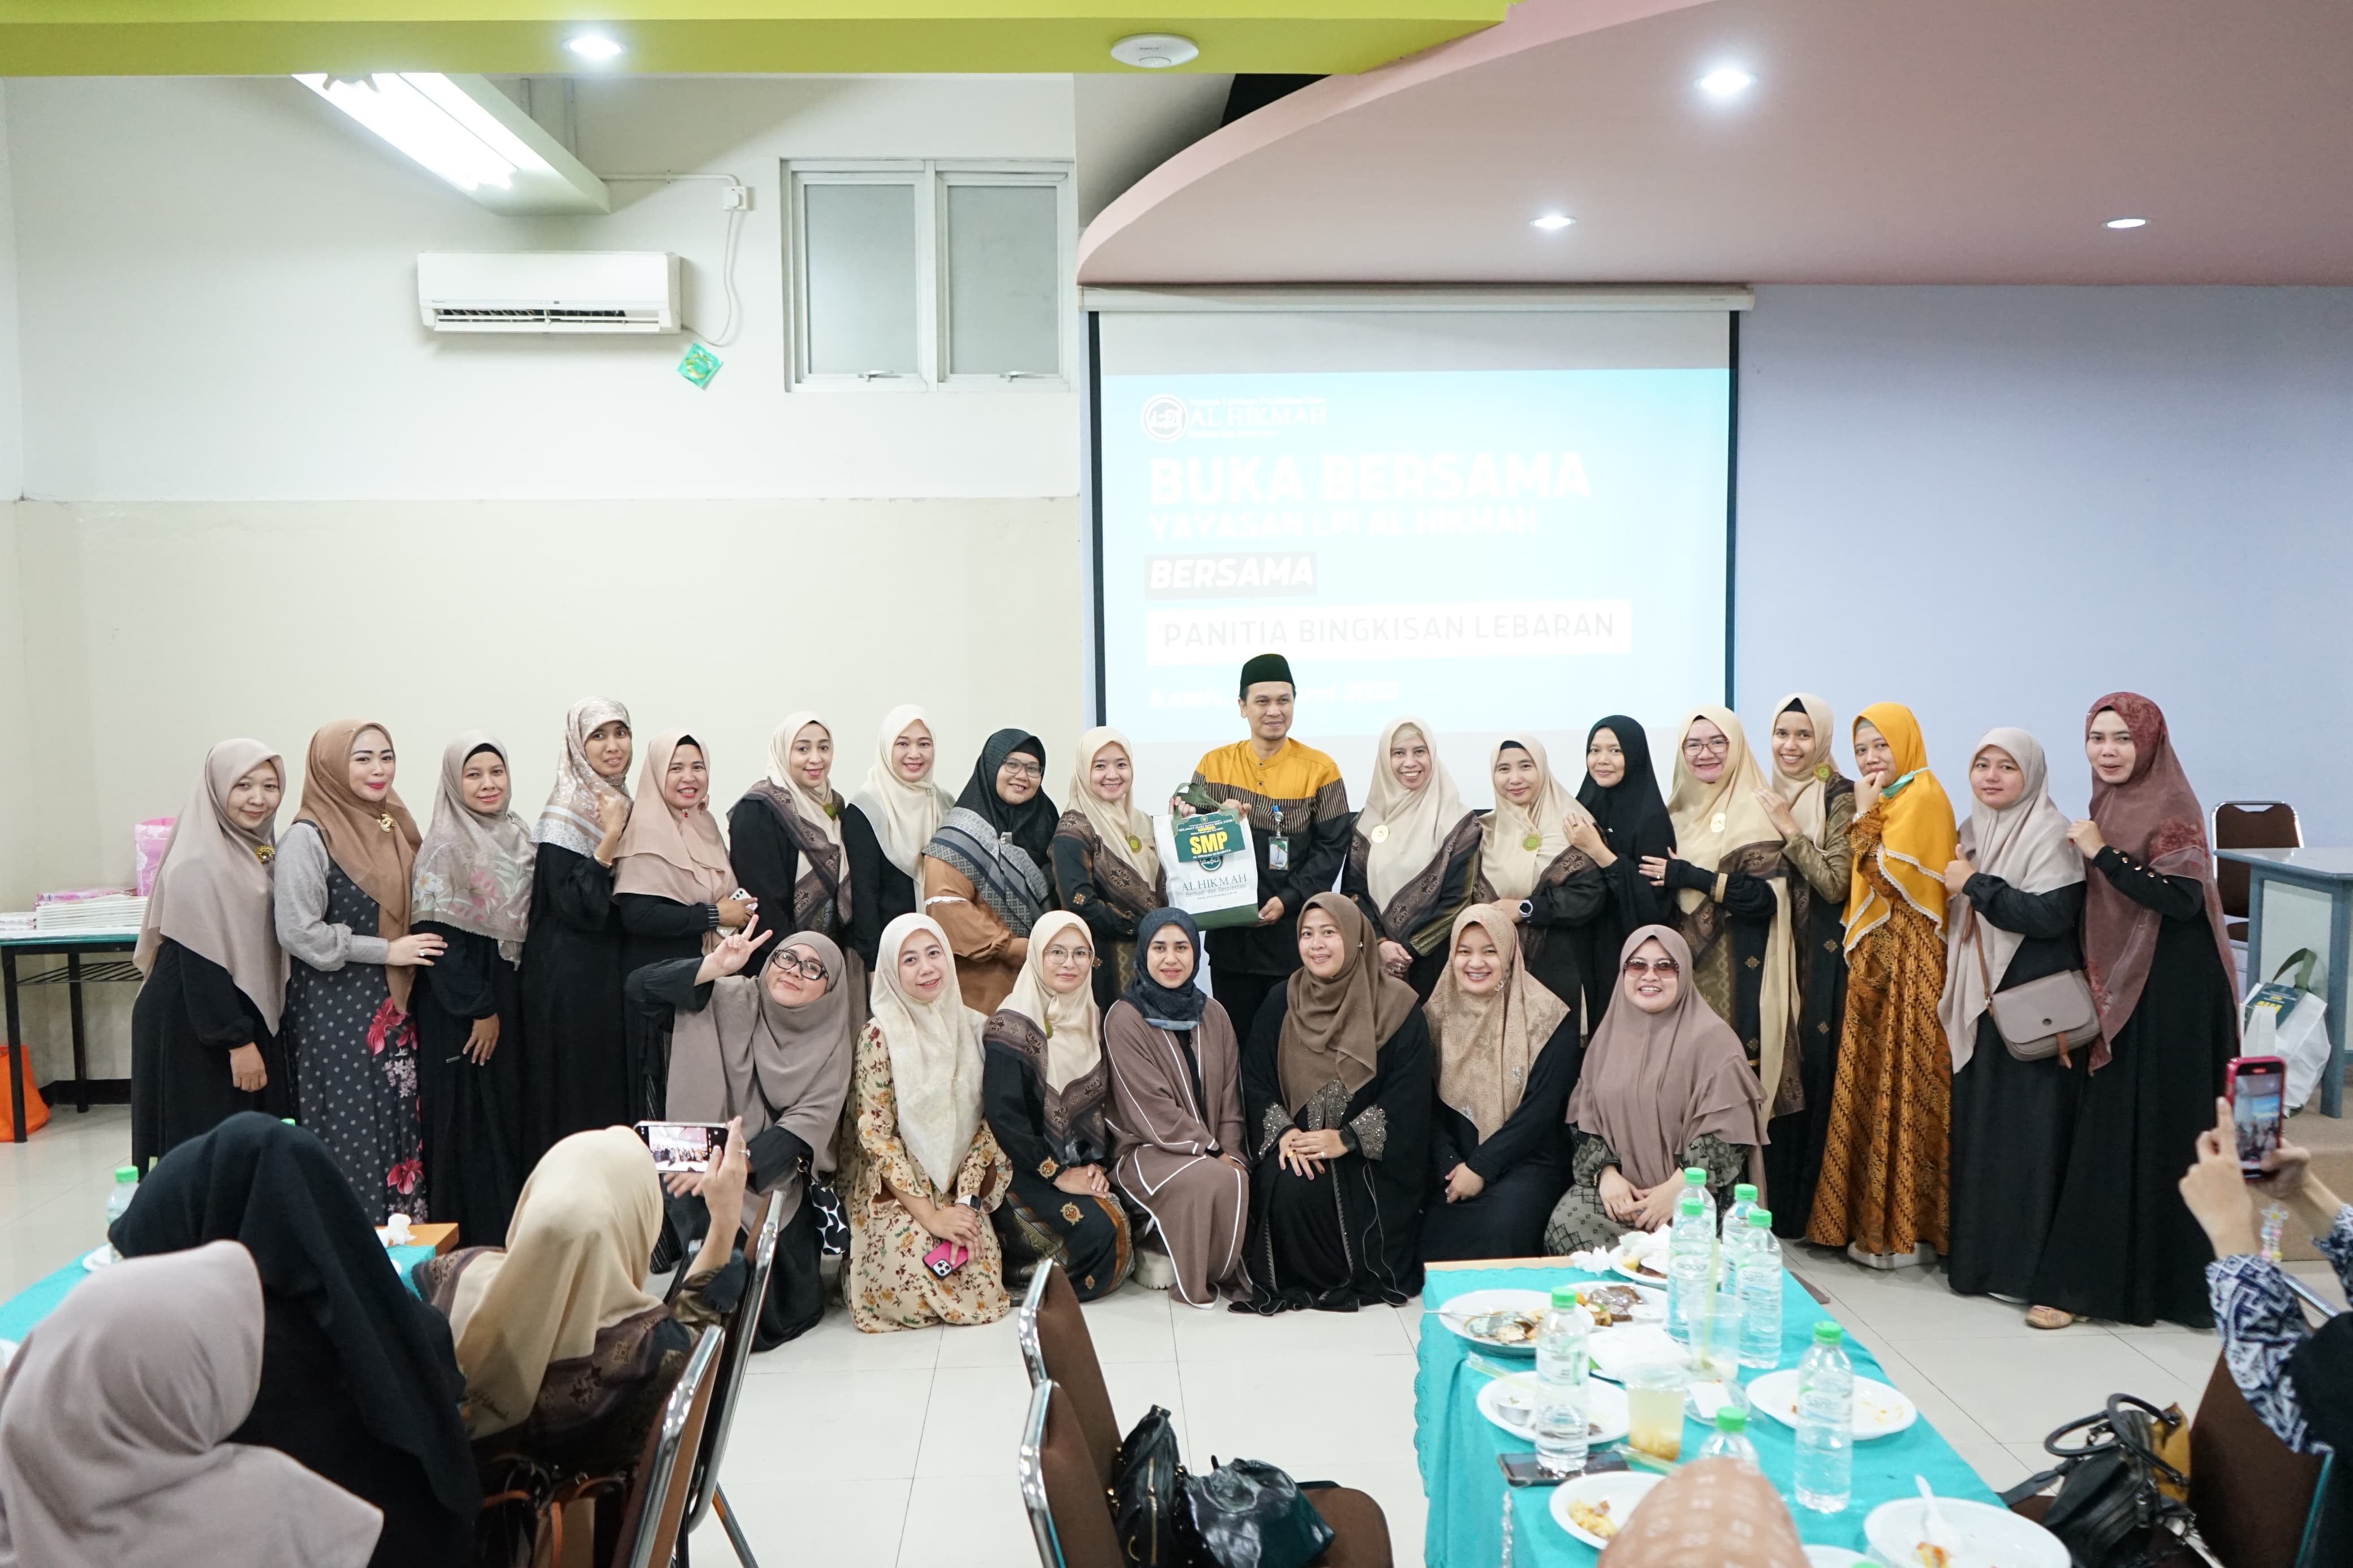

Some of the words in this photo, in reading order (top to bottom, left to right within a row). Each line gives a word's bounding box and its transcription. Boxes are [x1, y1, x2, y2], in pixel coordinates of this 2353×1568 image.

[1189, 407, 1222, 426] AL
[1227, 406, 1327, 426] HIKMAH
[1150, 456, 1304, 504] BUKA
[1321, 451, 1592, 501] BERSAMA
[1149, 510, 1303, 539] YAYASAN
[1312, 508, 1360, 537] LPI
[1369, 508, 1407, 537] AL
[1416, 506, 1538, 534] HIKMAH
[1150, 557, 1313, 589] BERSAMA
[1164, 620, 1288, 647] PANITIA
[1300, 617, 1464, 643] BINGKISAN
[1475, 614, 1614, 639] LEBARAN
[1190, 831, 1228, 855] SMP
[1182, 882, 1196, 892] AL
[1197, 873, 1247, 889] HIKMAH
[1218, 883, 1247, 893] Berprestasi
